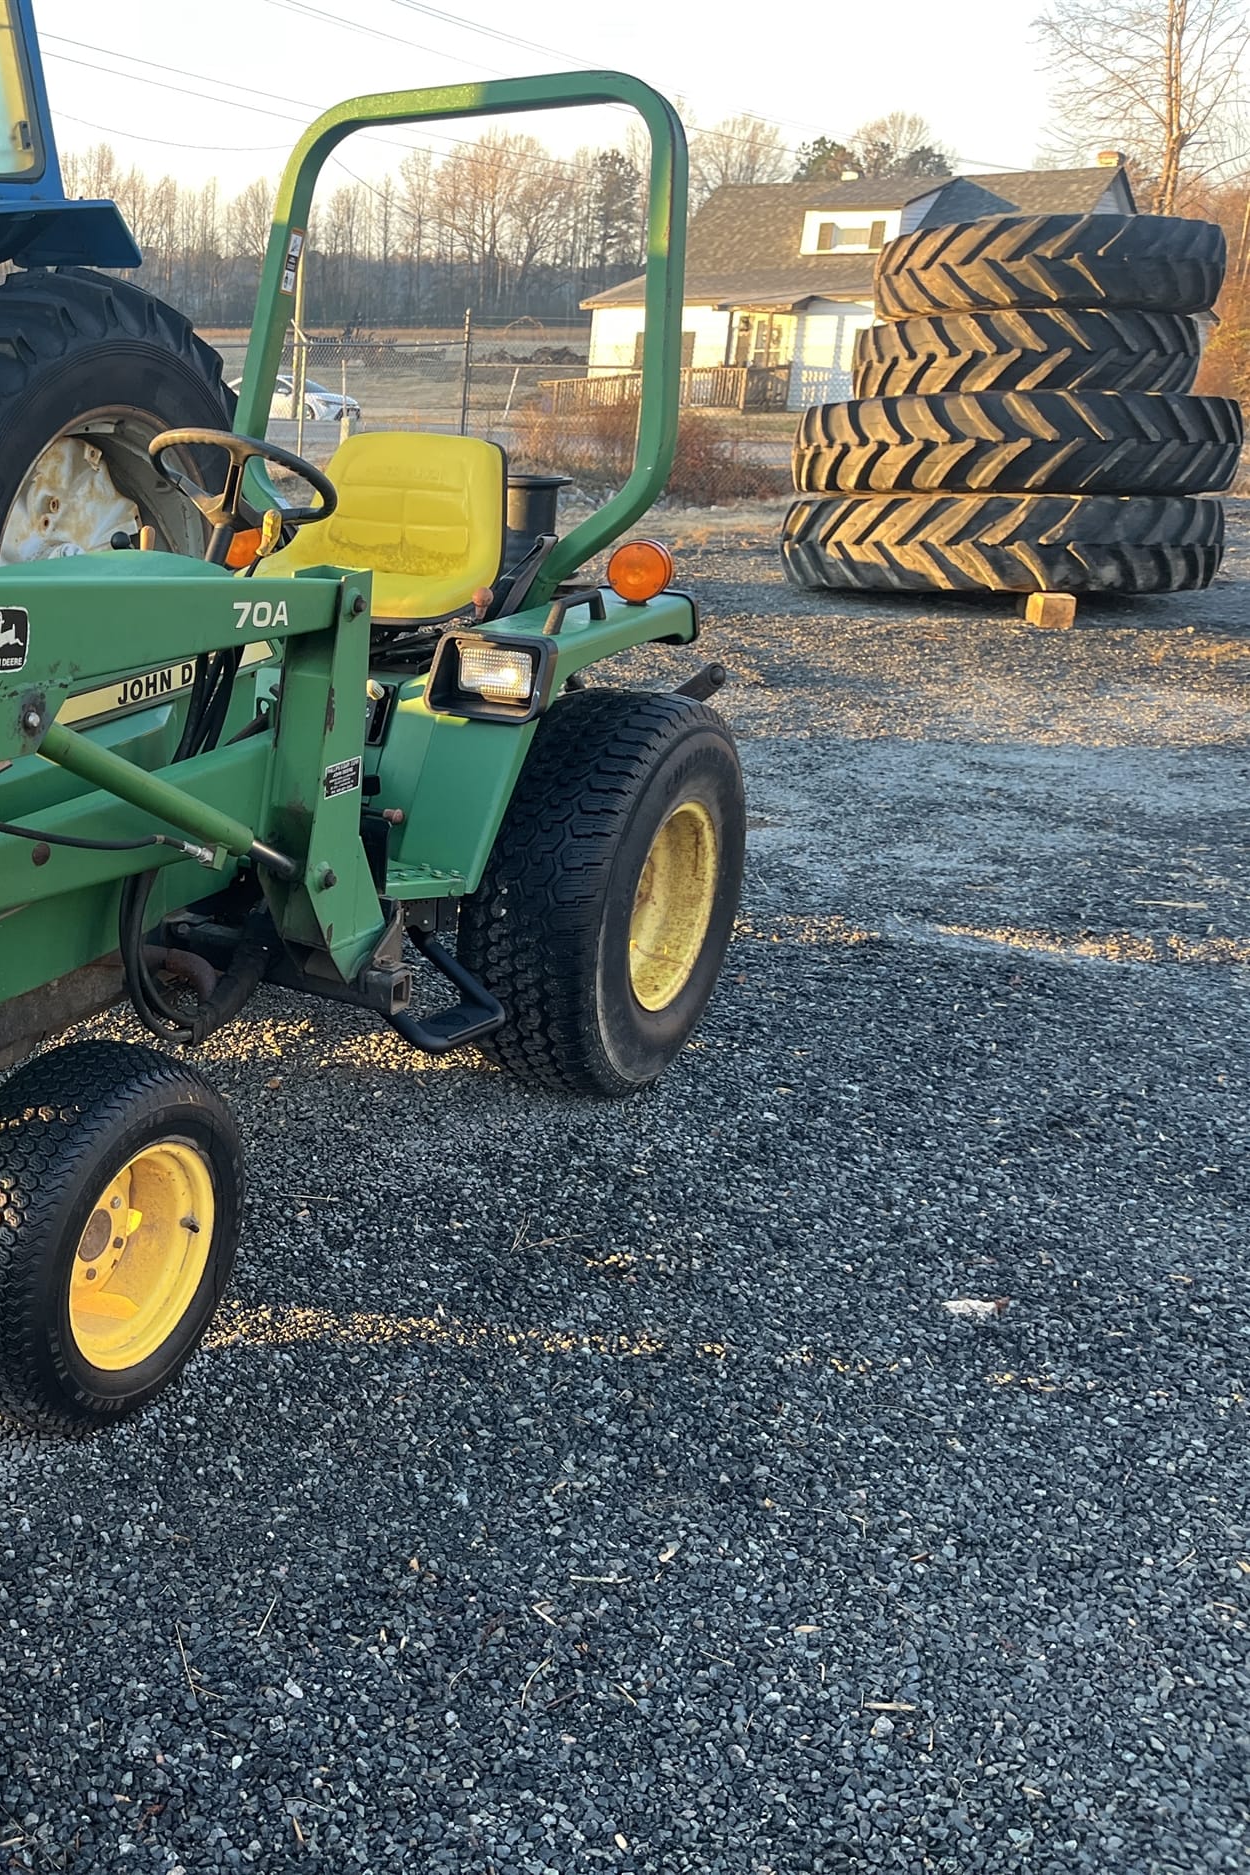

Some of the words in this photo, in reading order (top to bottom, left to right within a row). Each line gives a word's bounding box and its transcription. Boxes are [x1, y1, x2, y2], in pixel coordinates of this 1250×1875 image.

[233, 601, 288, 628] 70A
[2, 657, 22, 666] DEERE
[118, 669, 172, 705] JOHN
